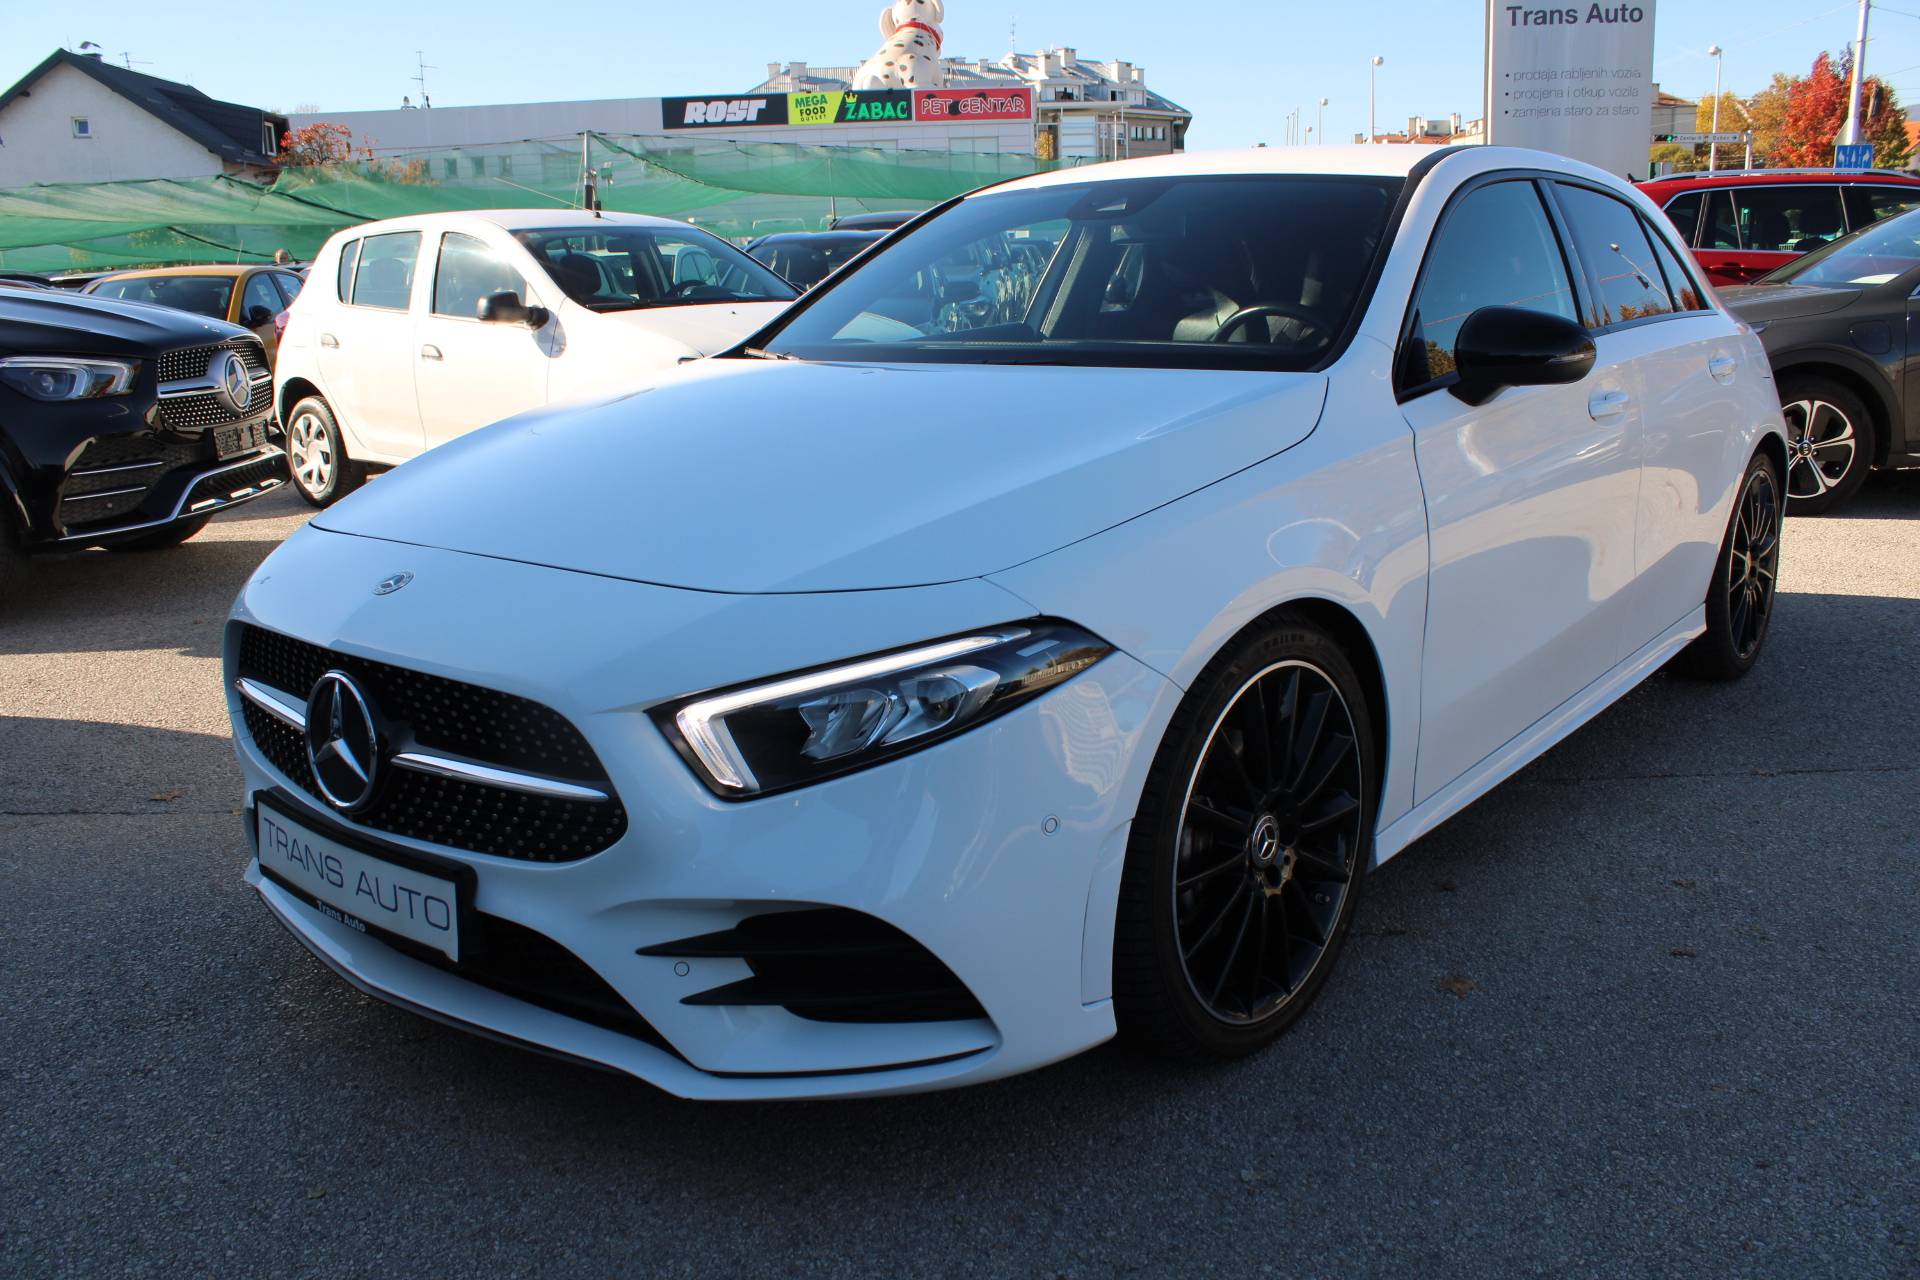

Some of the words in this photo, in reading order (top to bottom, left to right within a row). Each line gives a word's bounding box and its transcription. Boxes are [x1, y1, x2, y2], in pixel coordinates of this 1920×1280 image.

[1506, 5, 1578, 26] Trans
[1586, 3, 1644, 24] Auto
[1513, 68, 1557, 82] prodaja
[1560, 67, 1607, 81] rabljenih
[1611, 67, 1641, 79] vozila
[795, 94, 828, 109] MEGA
[1513, 87, 1563, 101] procjena
[1573, 86, 1605, 100] otkup
[1608, 85, 1639, 98] vozila
[683, 99, 767, 124] ROST
[800, 106, 826, 117] FOOD
[921, 98, 953, 115] PET
[958, 96, 1026, 114] CENTAR
[1512, 106, 1561, 120] zamjena
[1564, 104, 1593, 117] staro
[1596, 105, 1609, 117] za
[1612, 103, 1640, 116] staro
[801, 114, 827, 122] OUTLET
[264, 817, 344, 888] TRANS
[355, 871, 450, 931] AUTO
[316, 900, 342, 921] Trans
[344, 913, 366, 932] Auto
